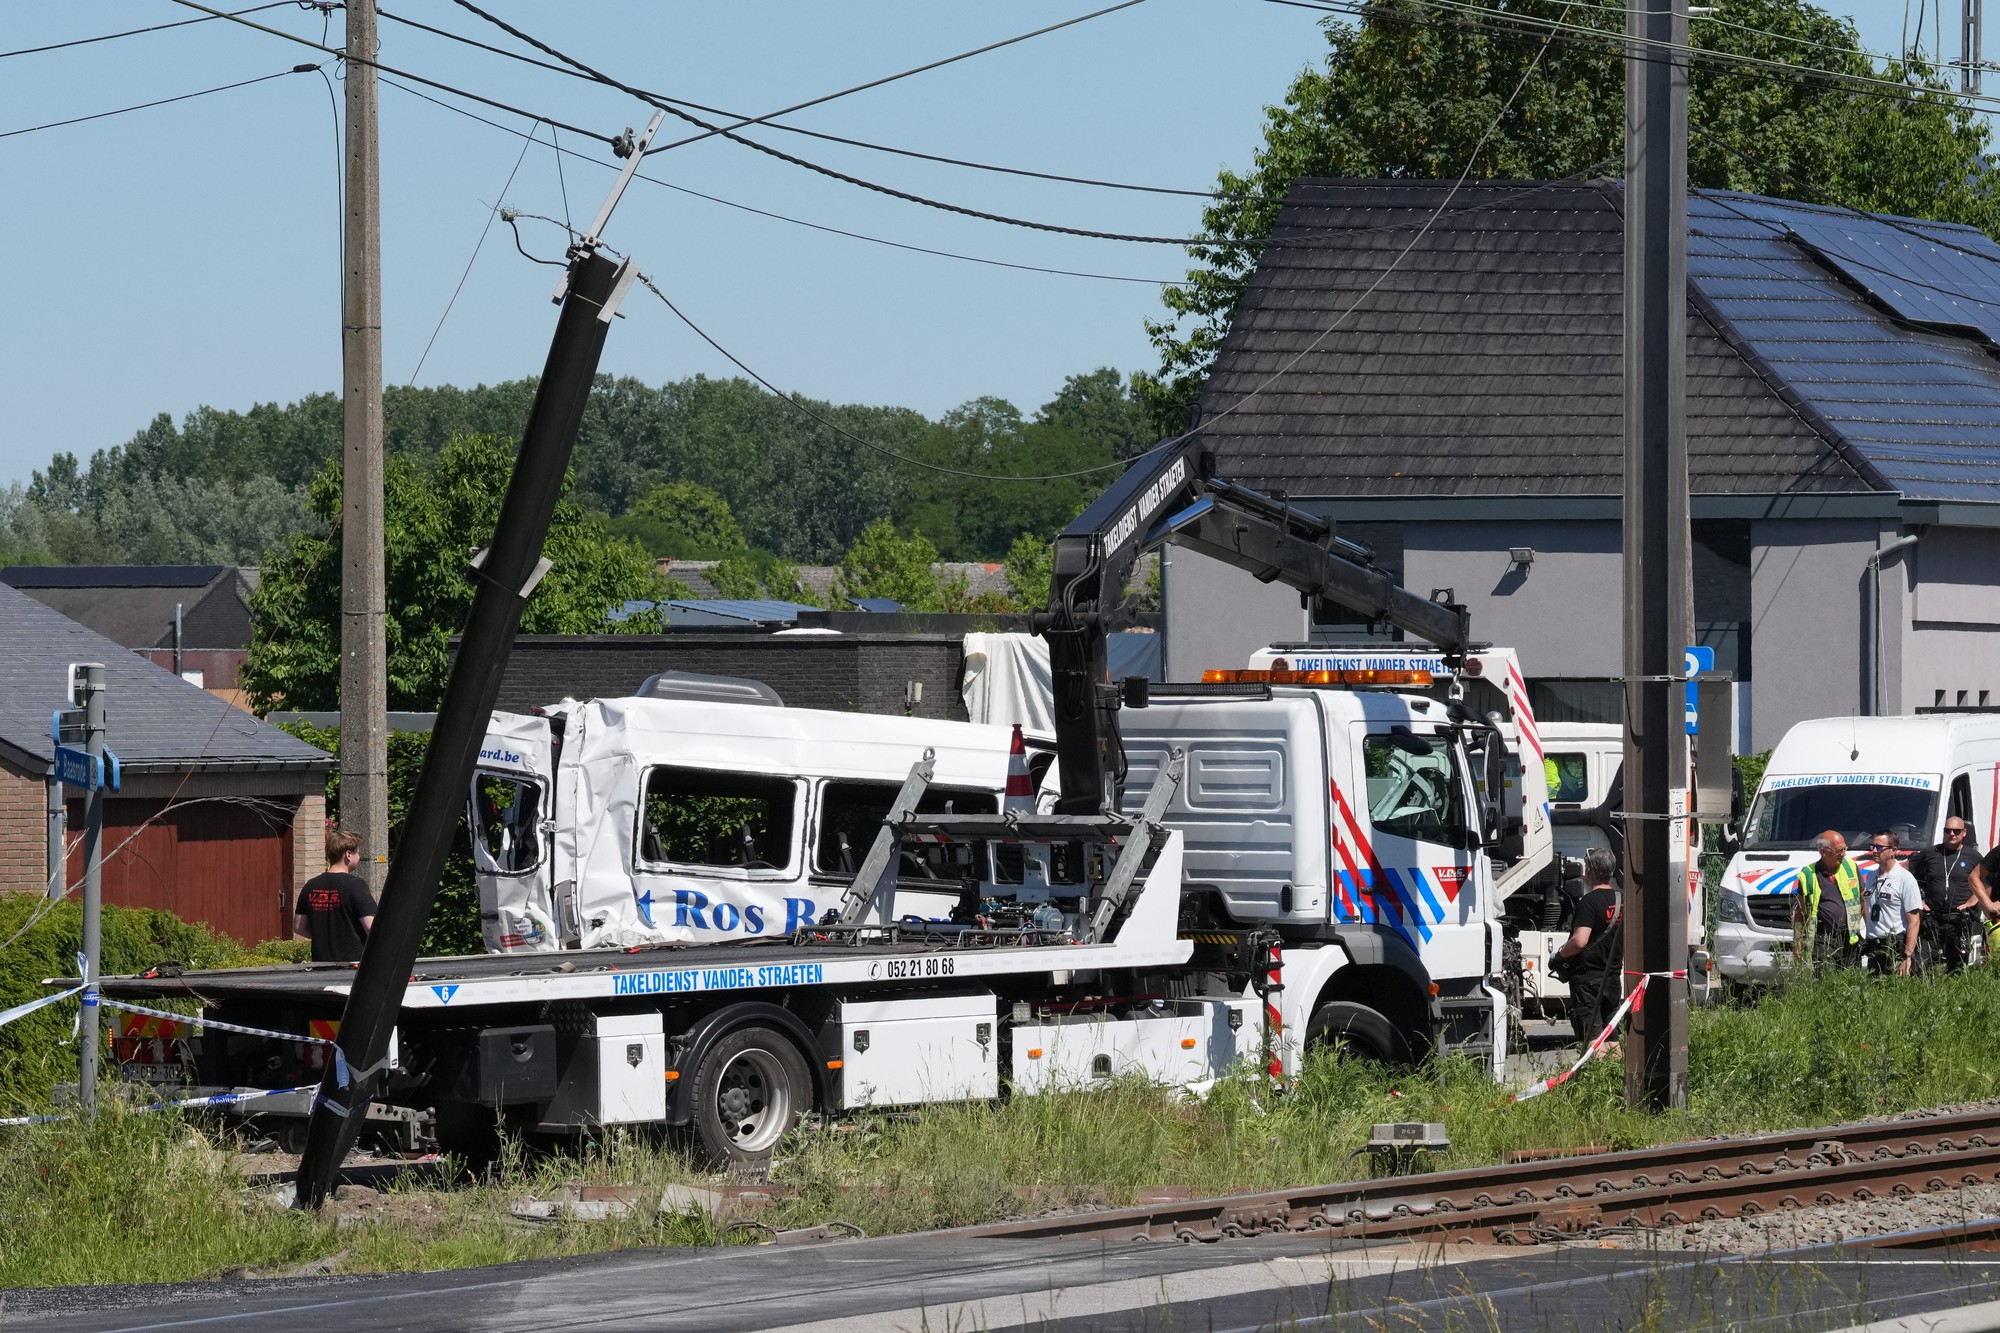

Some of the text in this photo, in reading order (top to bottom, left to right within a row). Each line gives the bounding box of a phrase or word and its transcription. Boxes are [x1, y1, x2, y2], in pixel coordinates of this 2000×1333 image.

[1103, 456, 1185, 559] TAKELDIENST VANDER STRAETEN
[1365, 659, 1406, 671] VANDER
[63, 753, 86, 783] Baasrode
[1771, 775, 1930, 789] TAKELDIENST VANDER STRAETEN
[671, 889, 764, 935] Ros
[613, 964, 823, 995] TAKELDIENST VANDER STRAETEN
[888, 958, 954, 978] 052 21 80 68
[442, 986, 449, 1001] 6
